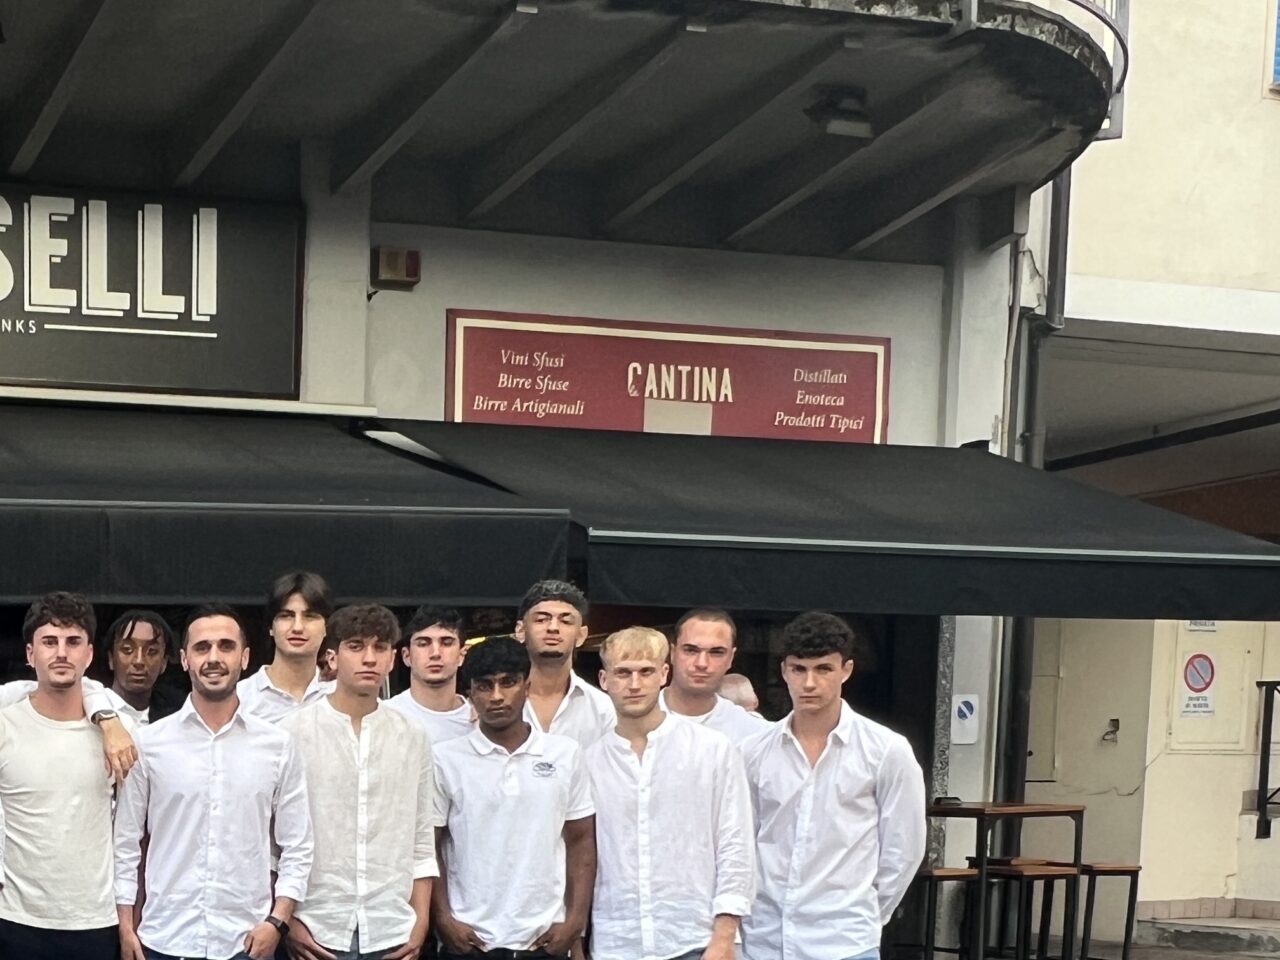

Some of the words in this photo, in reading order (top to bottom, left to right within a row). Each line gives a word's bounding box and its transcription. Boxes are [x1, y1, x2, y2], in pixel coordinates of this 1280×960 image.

[501, 349, 529, 366] Vini
[533, 351, 565, 371] Sfusi
[498, 373, 532, 389] Birre
[535, 375, 570, 394] Sfuse
[627, 362, 734, 403] CANTINA
[793, 368, 847, 384] Distillati
[473, 395, 508, 411] Birre
[511, 398, 585, 418] Artigianali
[796, 390, 845, 406] Enoteca
[774, 411, 825, 428] Prodotti
[829, 413, 865, 434] Tipici
